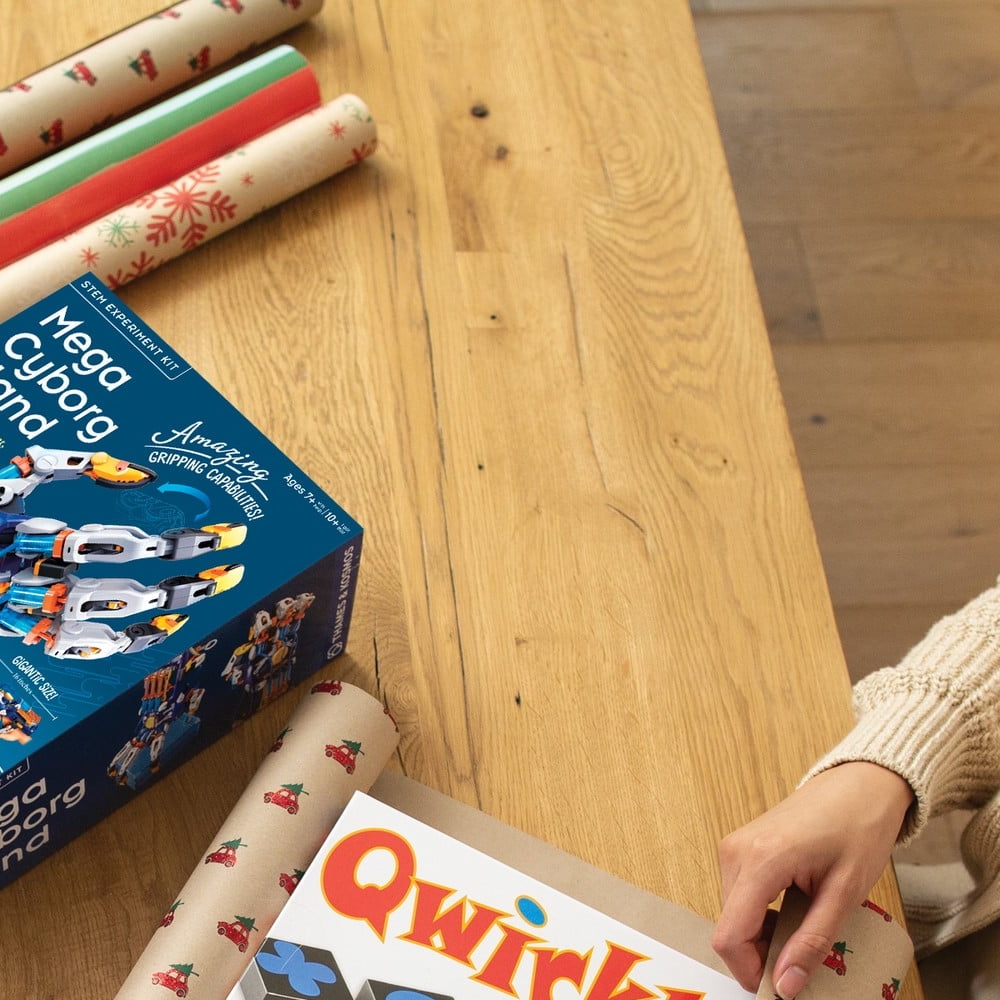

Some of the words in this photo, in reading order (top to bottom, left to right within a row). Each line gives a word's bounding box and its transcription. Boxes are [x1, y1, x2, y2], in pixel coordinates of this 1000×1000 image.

[39, 305, 132, 392] Mega
[81, 281, 107, 304] STEM
[105, 303, 163, 356] EXPERIMENT
[160, 357, 179, 371] KIT
[4, 332, 119, 444] Cyborg
[149, 452, 207, 474] GRIPPING
[206, 468, 264, 521] CAPABILITIES!
[151, 421, 270, 483] Amazing
[284, 473, 304, 495] Ages
[303, 492, 316, 504] 7+
[325, 512, 339, 526] 10+
[332, 600, 347, 643] THAMES
[340, 546, 353, 592] KOSMOS
[6, 766, 23, 780] KIT
